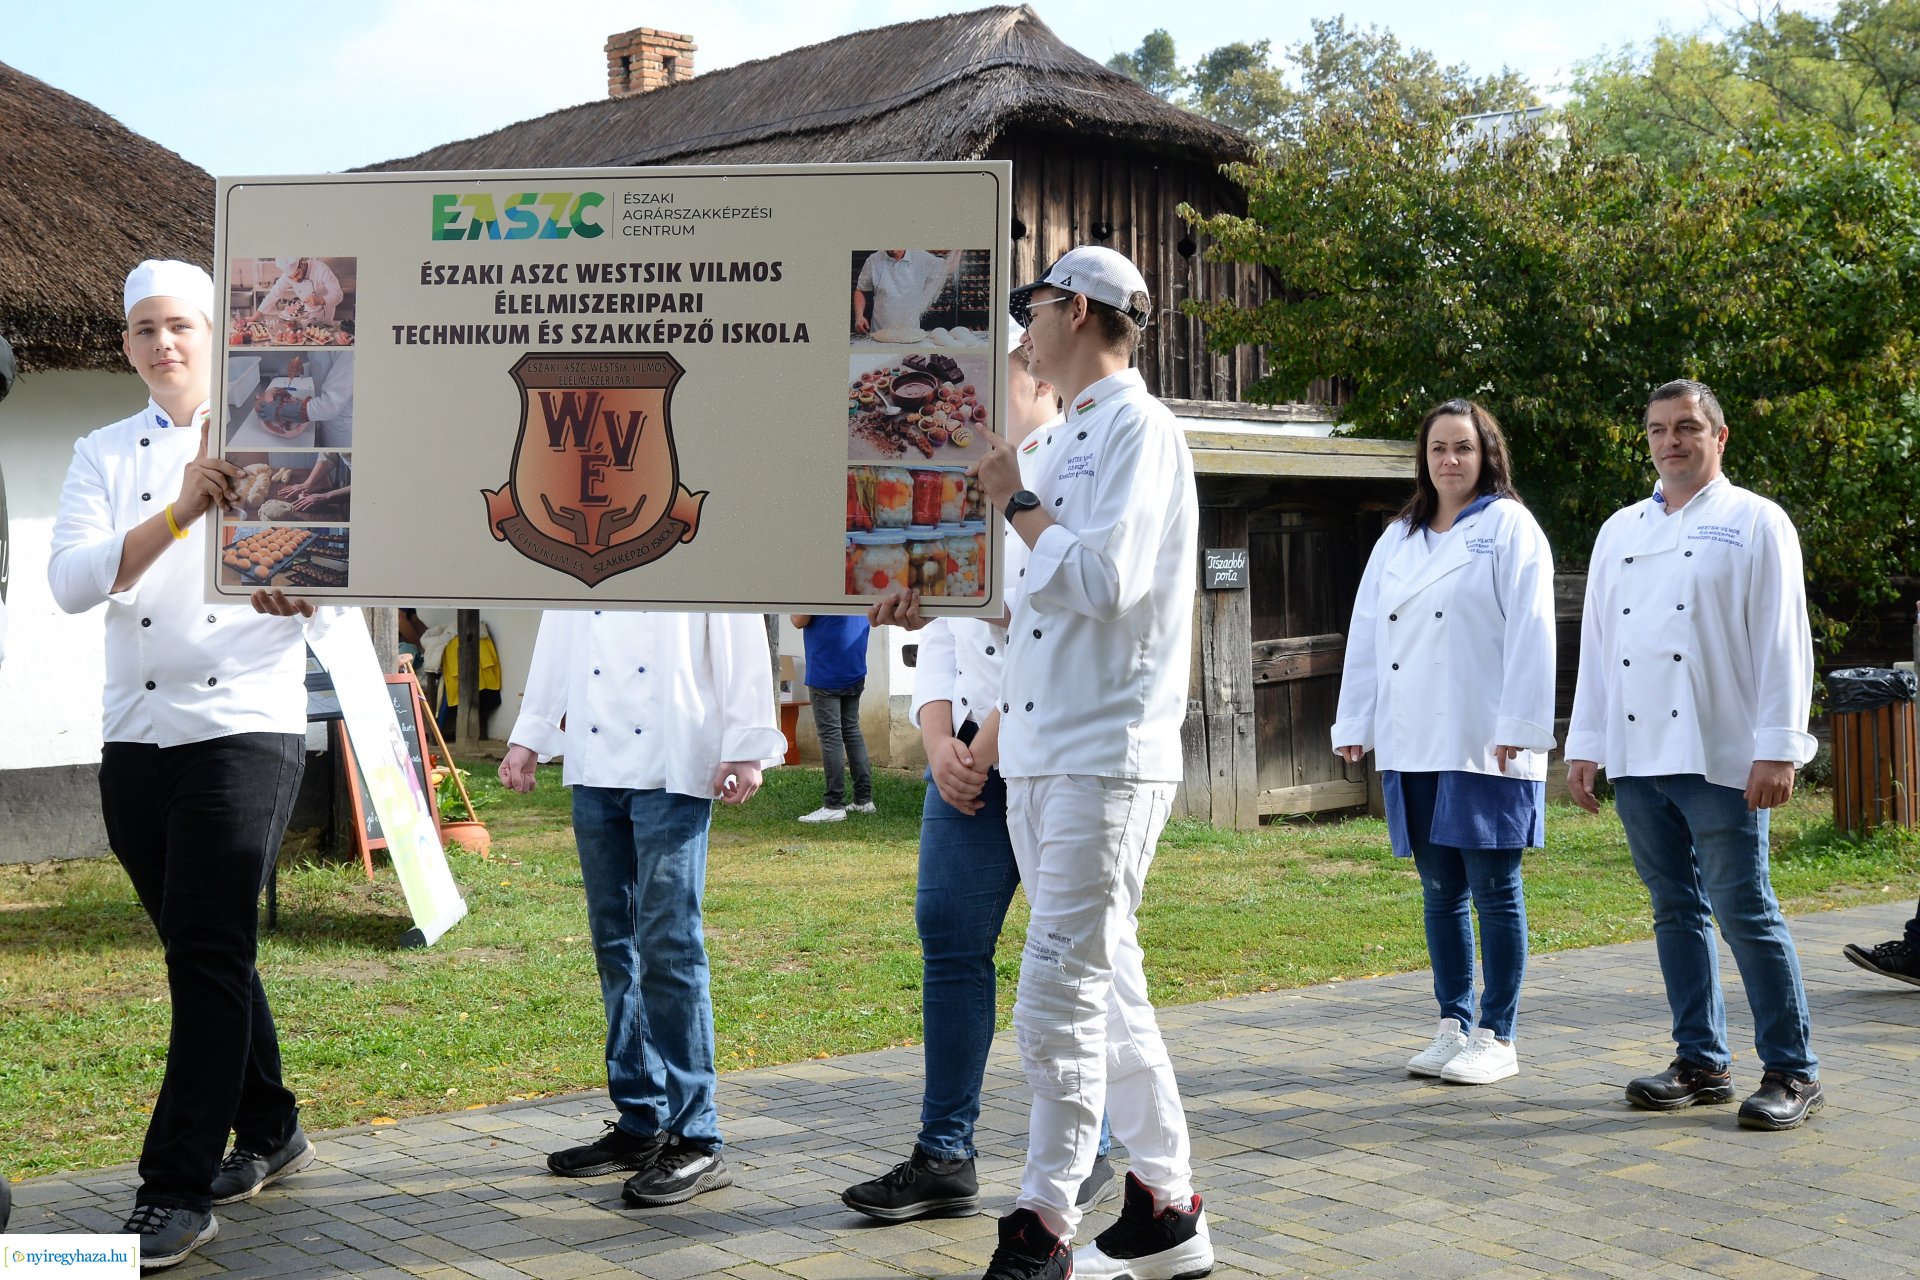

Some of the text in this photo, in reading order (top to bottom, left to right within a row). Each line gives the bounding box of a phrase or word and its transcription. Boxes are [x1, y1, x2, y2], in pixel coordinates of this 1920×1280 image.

[624, 192, 674, 204] ÉSZAKI
[623, 206, 772, 220] AGRÁRSZAKKÉPZÉSI
[623, 225, 695, 236] CENTRUM
[420, 261, 782, 285] ÉSZAKI ASZC WESTSIK VILMOS
[494, 290, 703, 314] ÉLELMISZERIPARI
[392, 319, 810, 345] TECHNIKUM ÉS SZAKKÉPZŐ ISKOLA
[564, 362, 586, 372] ASZC
[590, 362, 629, 372] WESTSIK
[632, 362, 667, 372] VILMOS
[510, 521, 569, 566] TECHNIKUM
[650, 521, 679, 550] ISKOLA
[1213, 569, 1238, 585] porta
